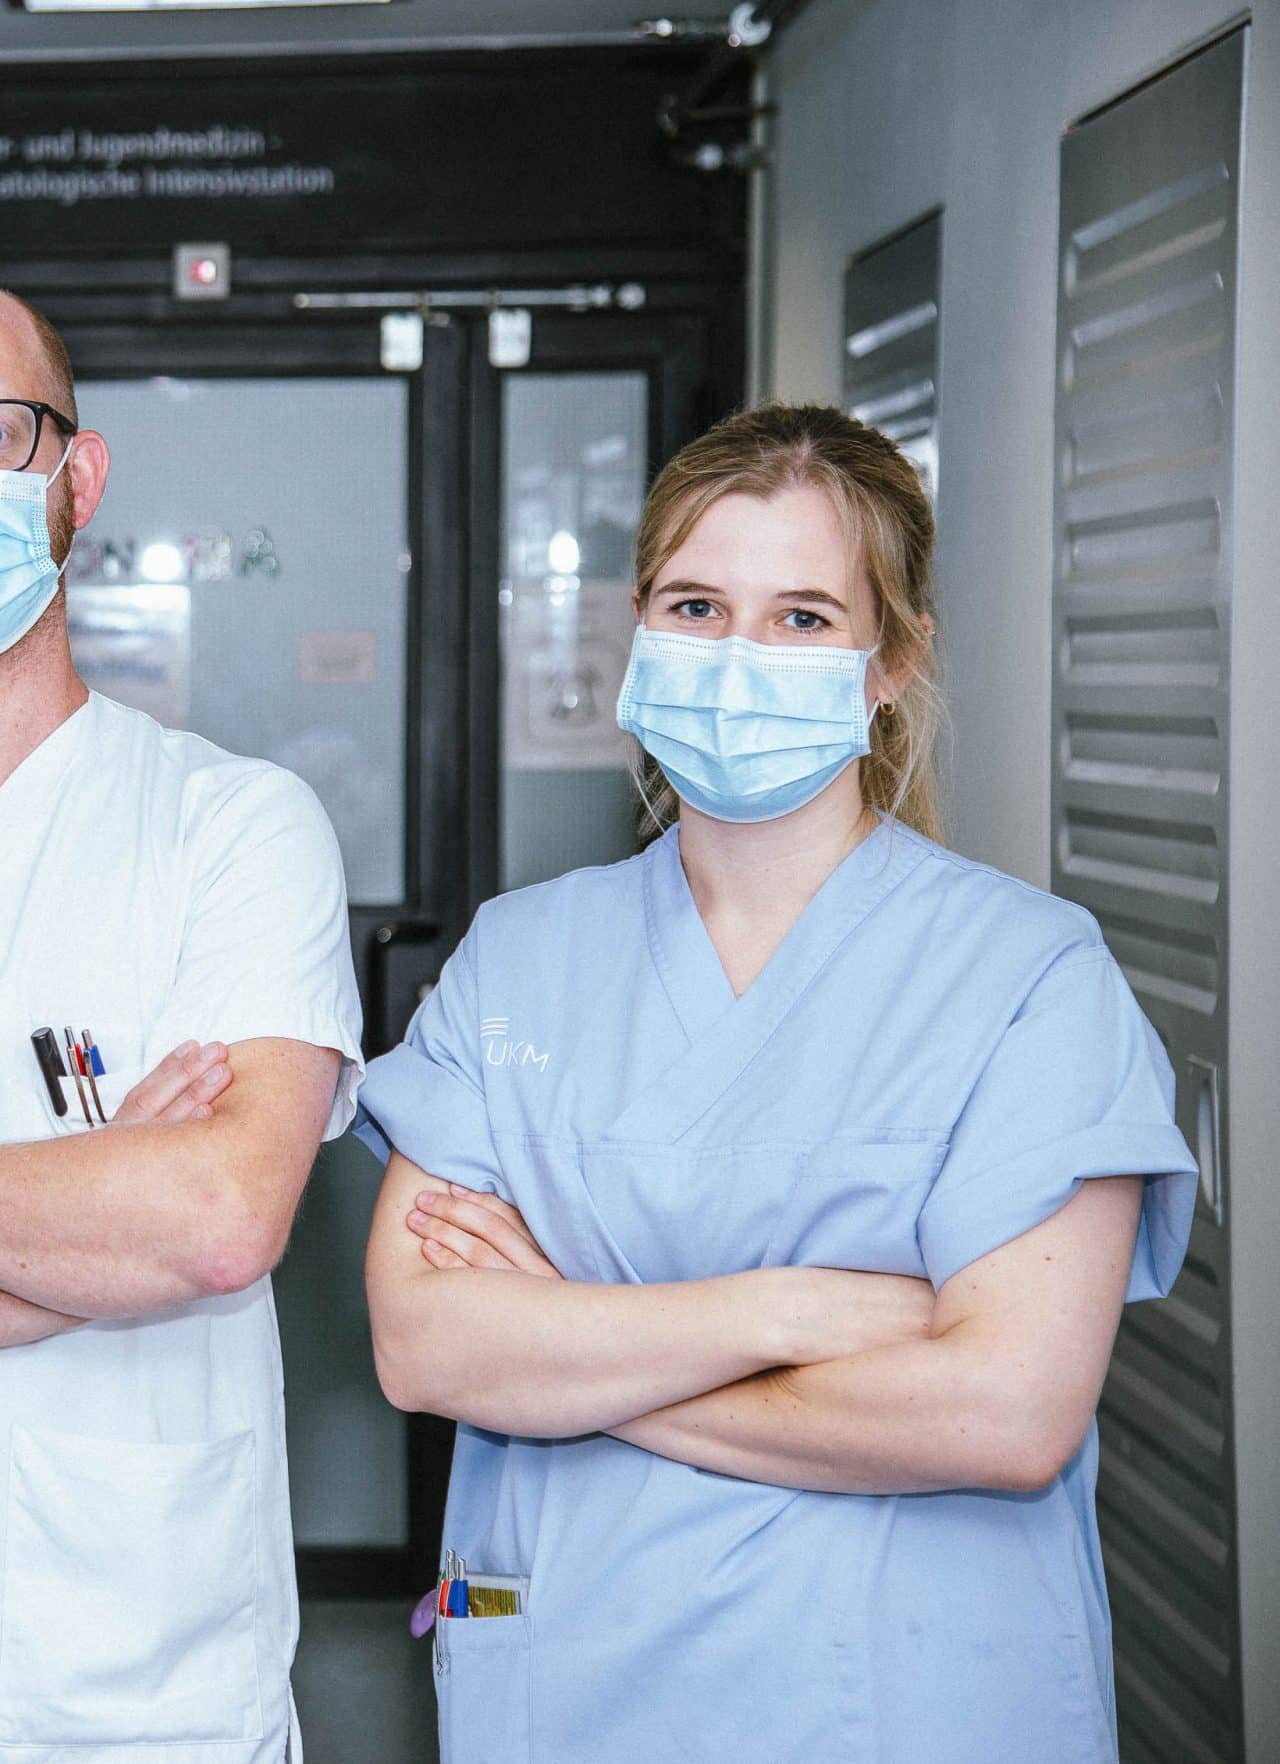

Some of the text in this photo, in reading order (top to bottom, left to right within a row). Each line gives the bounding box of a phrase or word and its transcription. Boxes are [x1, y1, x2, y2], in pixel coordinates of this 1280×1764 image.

[23, 128, 75, 161] und
[78, 126, 265, 168] Jugendmedizin
[144, 163, 334, 197] Intensivstation
[486, 1039, 549, 1072] UKM
